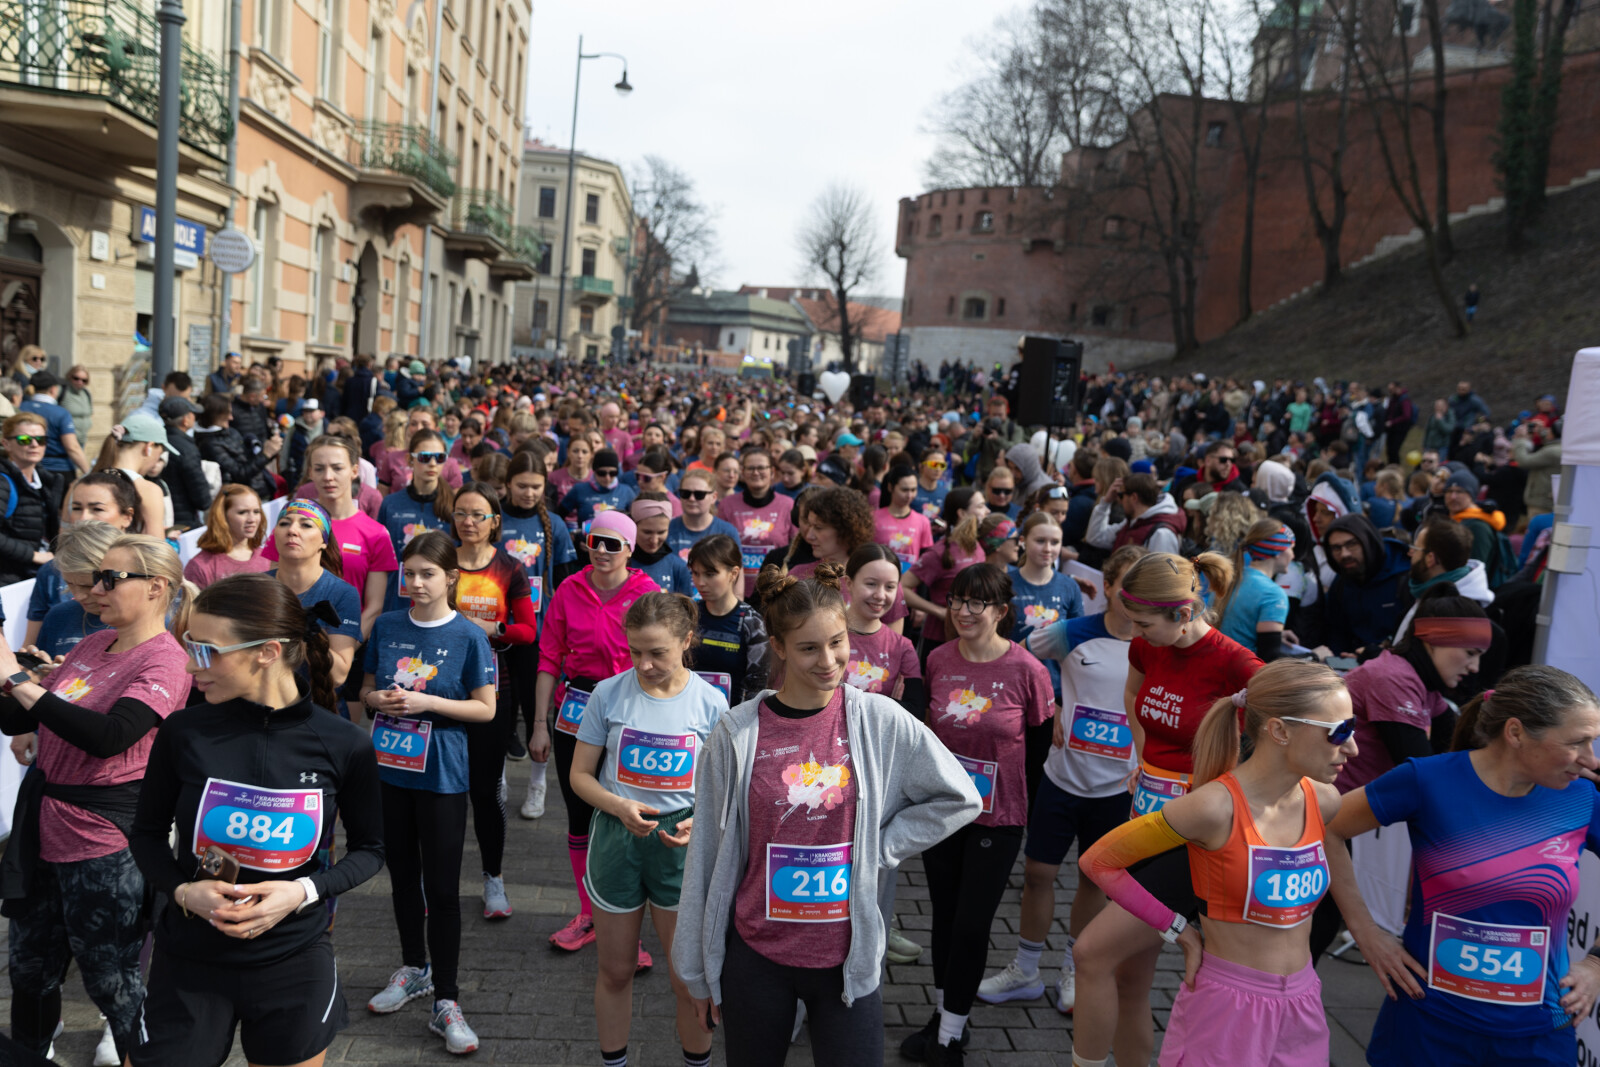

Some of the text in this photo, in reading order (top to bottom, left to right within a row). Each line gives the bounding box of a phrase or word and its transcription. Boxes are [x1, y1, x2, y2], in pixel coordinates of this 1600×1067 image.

[142, 213, 197, 248] AOLE
[1144, 696, 1182, 714] need is
[1149, 685, 1184, 703] all you
[379, 730, 413, 753] 574
[1084, 721, 1120, 744] 321
[629, 747, 688, 772] 1637
[1134, 790, 1171, 815] 167
[225, 811, 294, 845] 884
[791, 868, 848, 897] 216
[1267, 868, 1323, 901] 1880
[1458, 944, 1524, 978] 554
